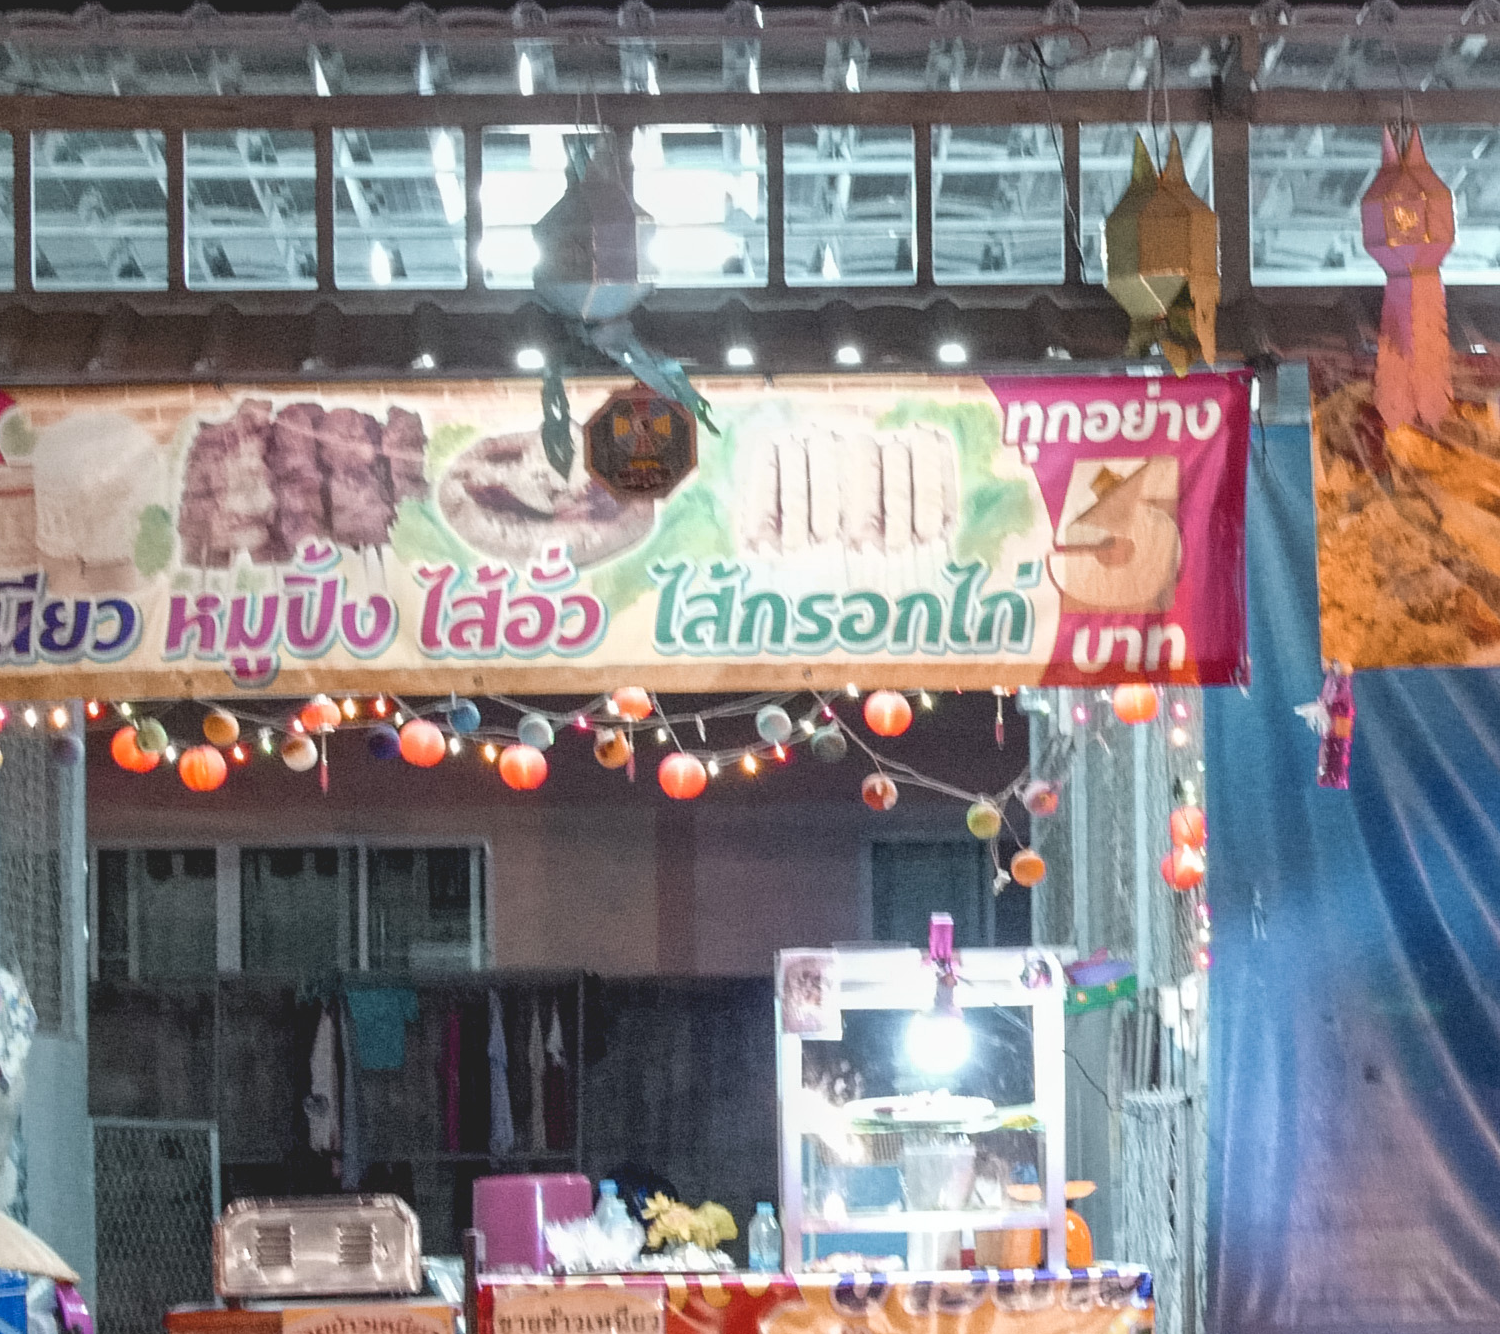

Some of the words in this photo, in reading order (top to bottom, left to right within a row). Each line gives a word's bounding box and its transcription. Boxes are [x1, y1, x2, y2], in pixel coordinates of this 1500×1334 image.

[1004, 381, 1222, 464] ทุกอย่าง
[1048, 455, 1183, 613] 5
[164, 537, 399, 687] หมูปิ้ง
[417, 546, 608, 657] ไส้อั่ว
[649, 560, 1041, 656] ไส้กรอกไก่
[1072, 624, 1187, 673] บาท
